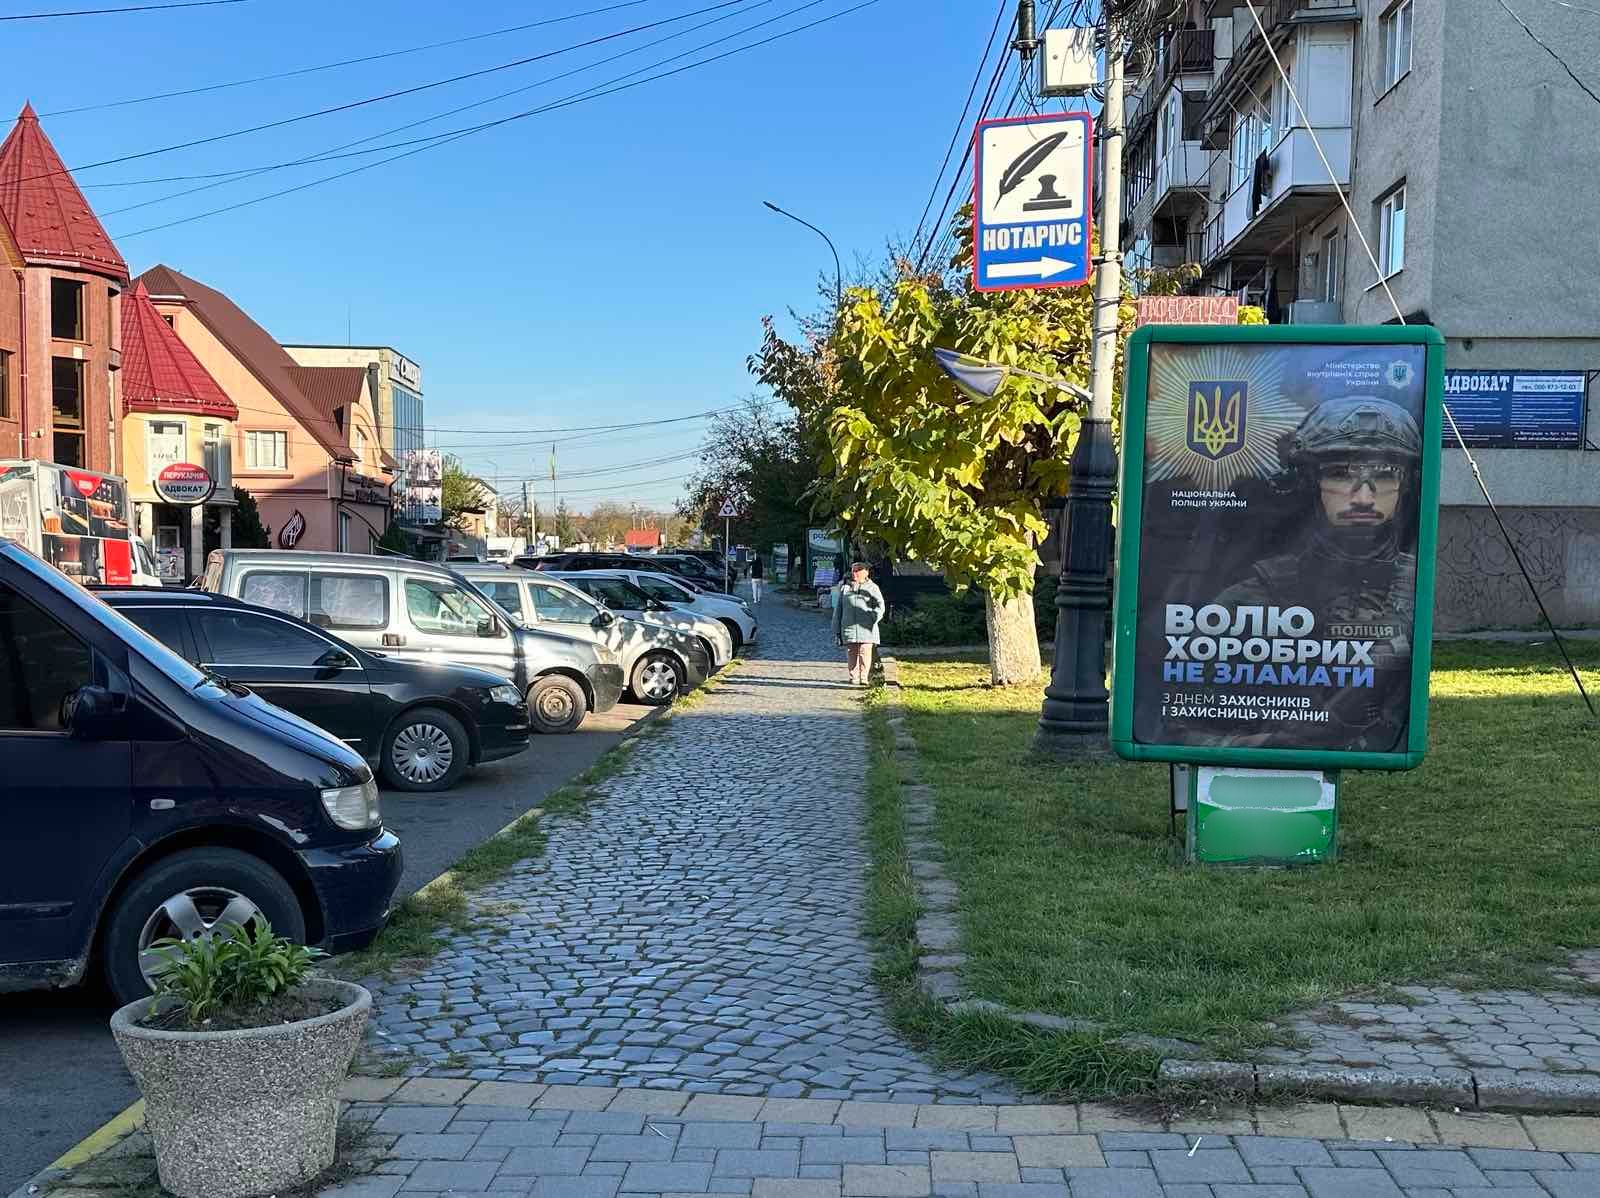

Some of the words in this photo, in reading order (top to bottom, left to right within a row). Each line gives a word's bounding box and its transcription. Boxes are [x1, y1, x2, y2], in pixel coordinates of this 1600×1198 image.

[983, 223, 1082, 251] НОТАРІУС
[1325, 362, 1380, 370] Міністерство
[165, 485, 203, 493] АДВОКАТ
[1172, 491, 1236, 499] НАЦІОНАЛЬНА
[1171, 500, 1206, 508] ПОЛІЦІЯ
[1209, 499, 1247, 508] УКРАЇНИ
[1165, 603, 1315, 638] ВОЛЮ
[1329, 624, 1394, 638] ПОЛІЦІЯ
[1165, 636, 1375, 665] ХОРОБРИХ
[1163, 662, 1205, 683] НЕ
[1214, 663, 1375, 688] ЗЛАМАТИ
[1162, 692, 1171, 704] З
[1173, 693, 1215, 707] ДНЕМ
[1219, 695, 1311, 708] ЗАХИСНИКІВ
[1162, 706, 1166, 717] І
[1170, 706, 1258, 720] ЗАХИСНИЦЬ
[1261, 707, 1329, 722] УКРАЇНИ!
